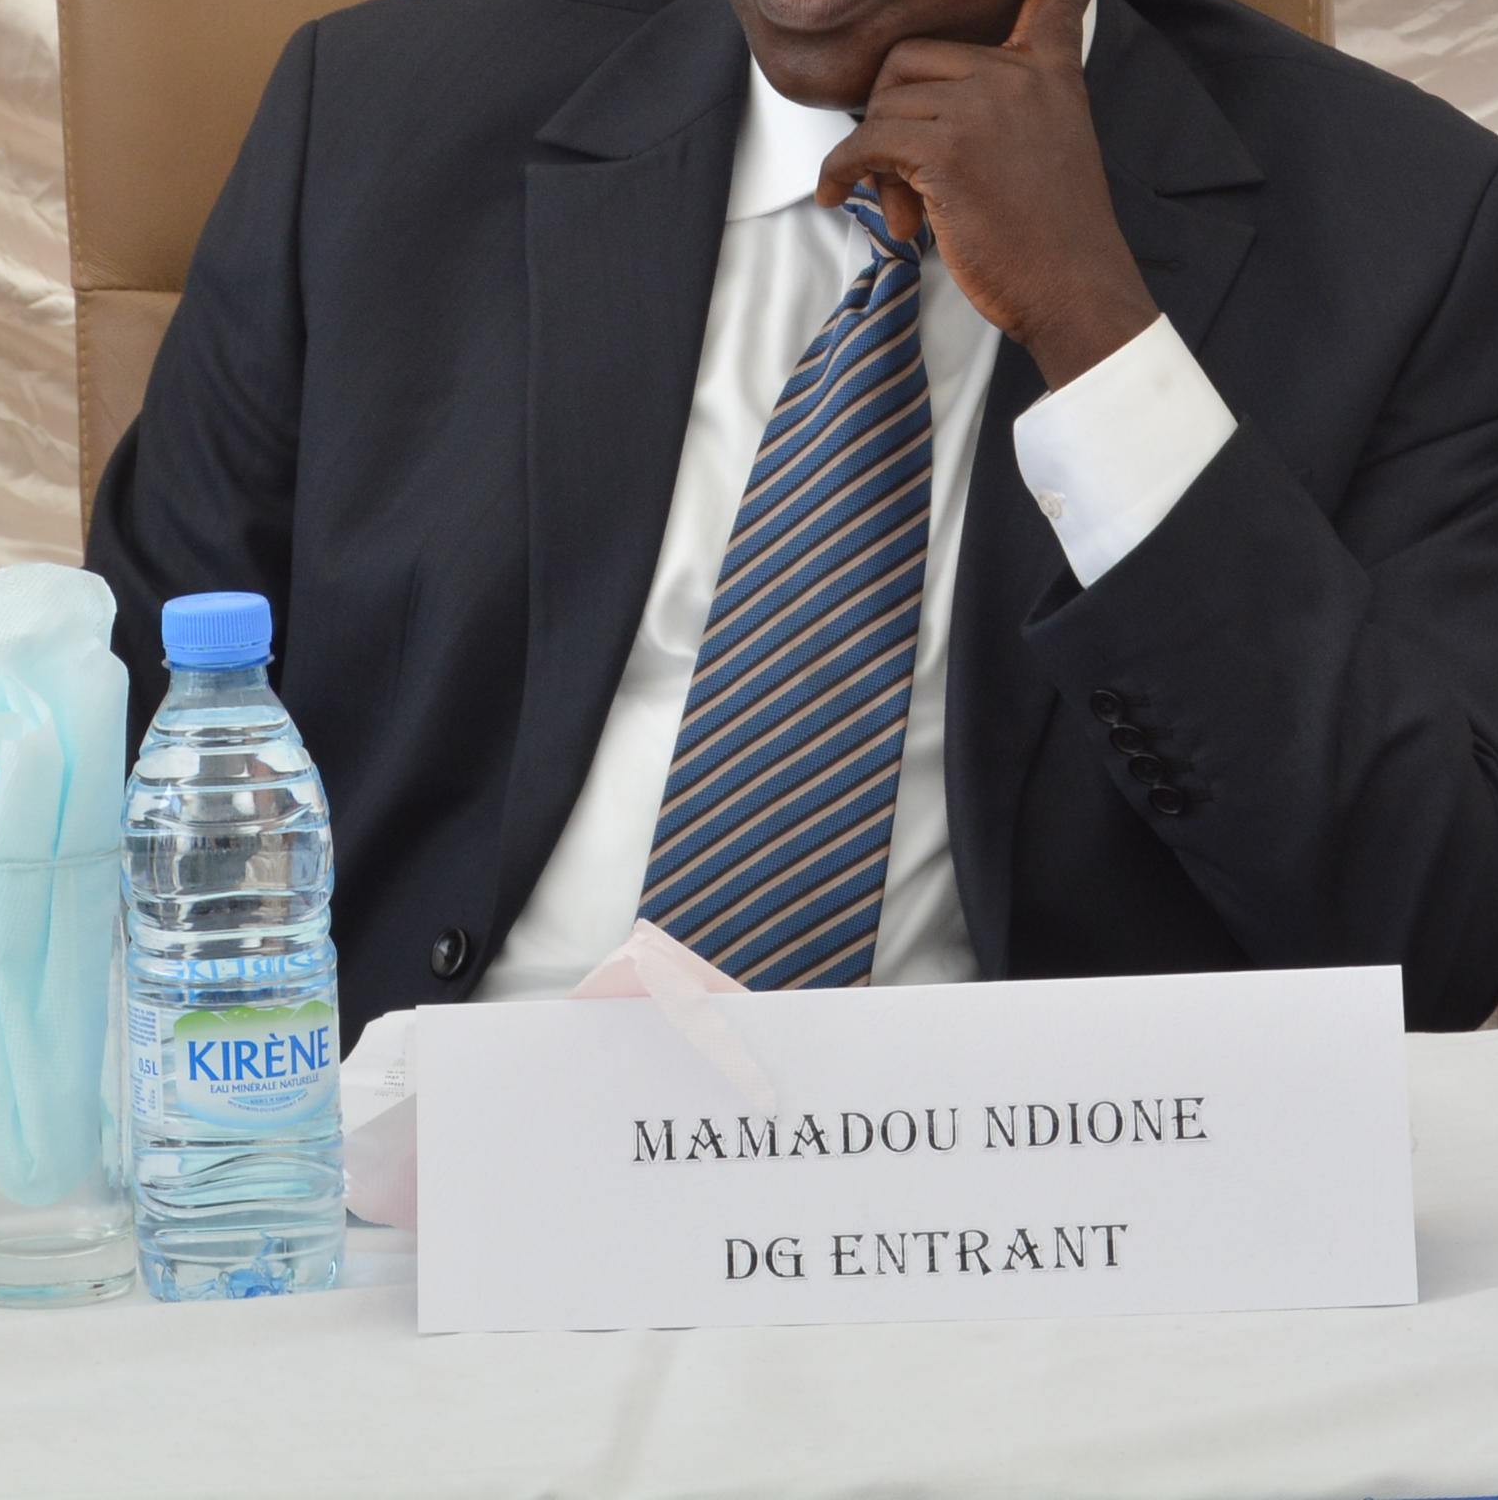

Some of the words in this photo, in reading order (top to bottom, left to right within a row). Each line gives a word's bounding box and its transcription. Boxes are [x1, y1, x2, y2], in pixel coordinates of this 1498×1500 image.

[139, 1058, 152, 1075] 0,5
[188, 1026, 330, 1081] KIRÈNE
[210, 1084, 230, 1094] EAU
[232, 1081, 277, 1094] MINÉRALE
[280, 1072, 320, 1088] NATURELLE
[632, 1107, 958, 1162] MAMADOU
[985, 1097, 1209, 1149] NDIONE
[725, 1237, 805, 1280] DG
[830, 1224, 1129, 1277] ENTRANT
